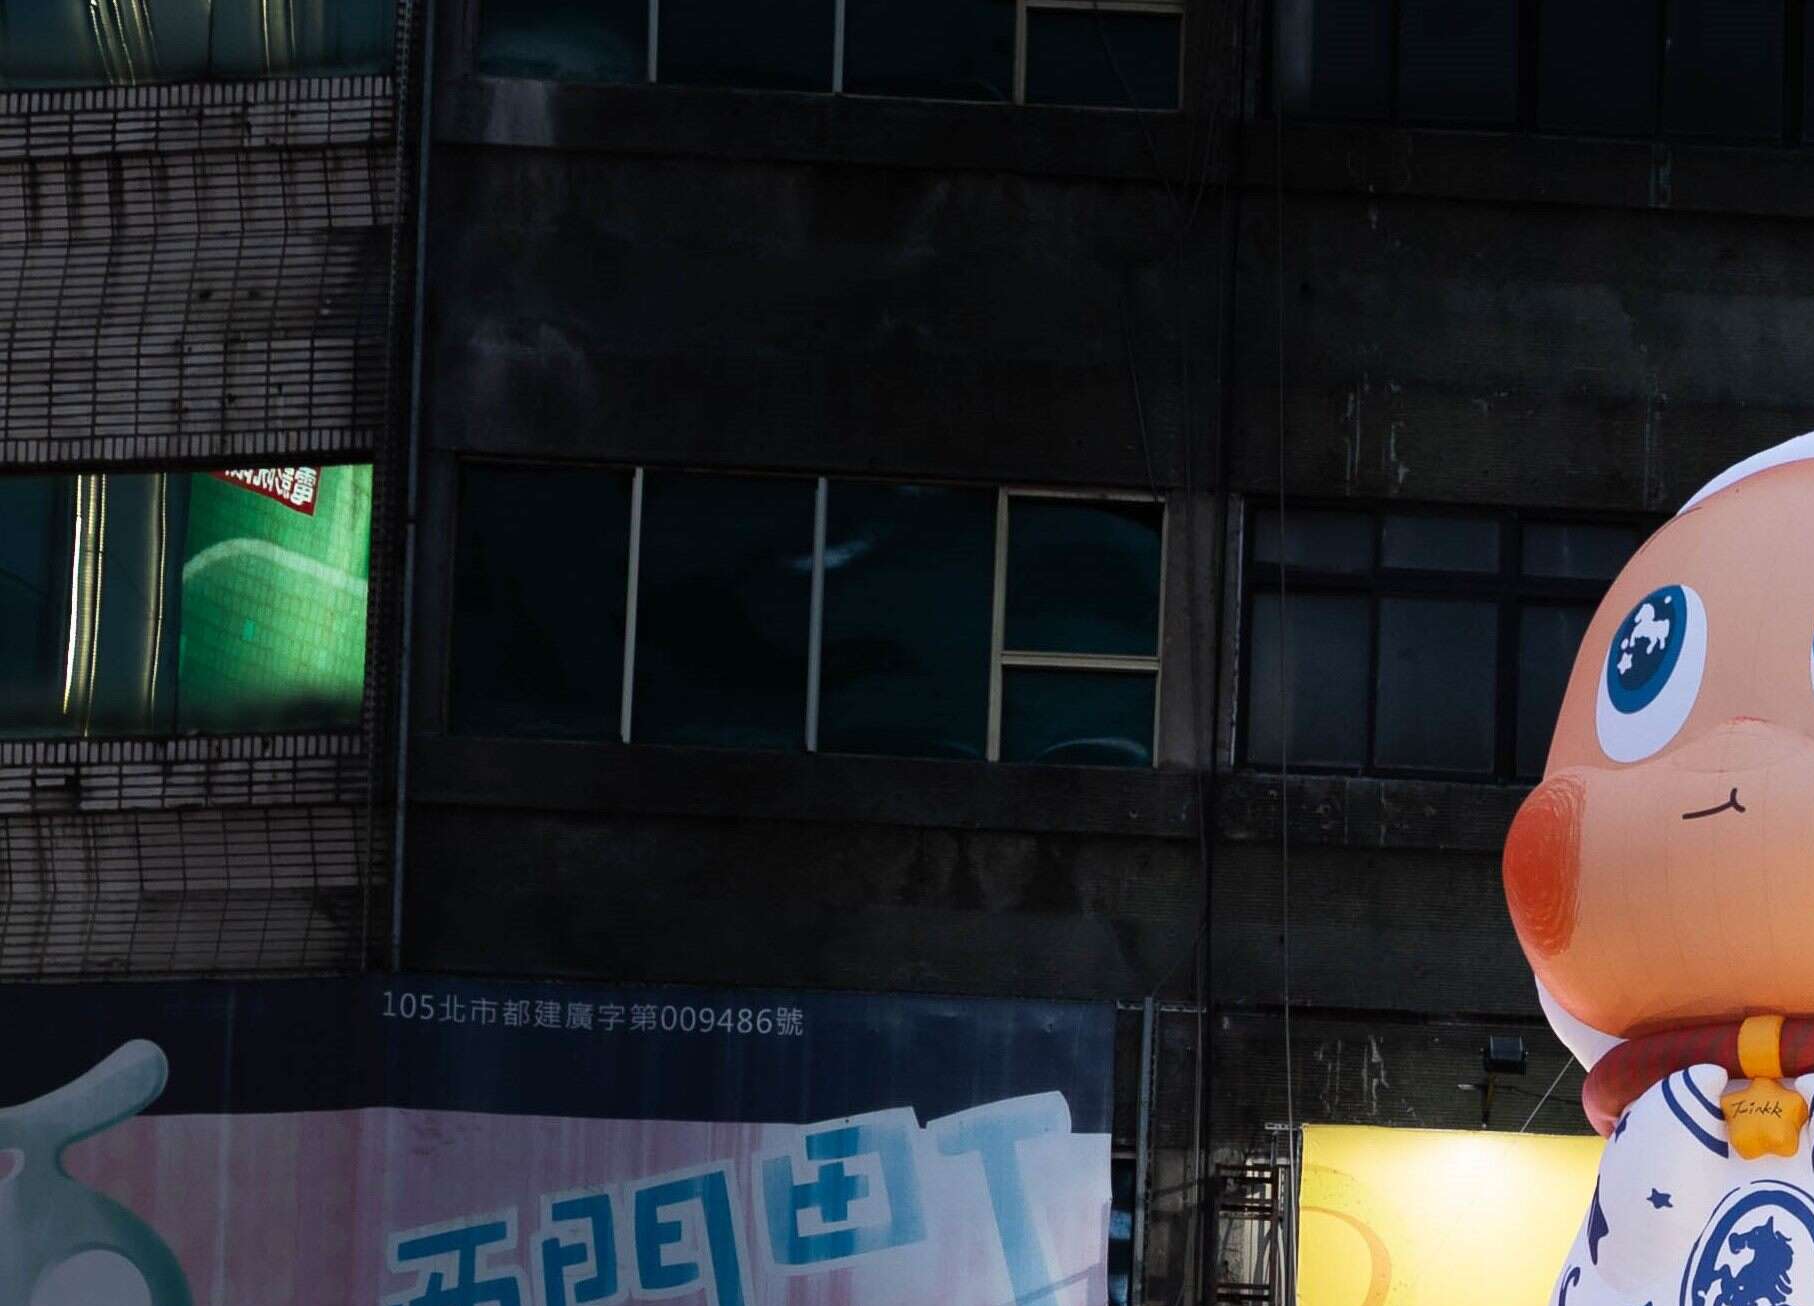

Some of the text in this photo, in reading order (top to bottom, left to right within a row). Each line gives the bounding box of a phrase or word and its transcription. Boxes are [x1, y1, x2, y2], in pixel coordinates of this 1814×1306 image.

[381, 990, 805, 1038] 105北市都建廣字第009486號
